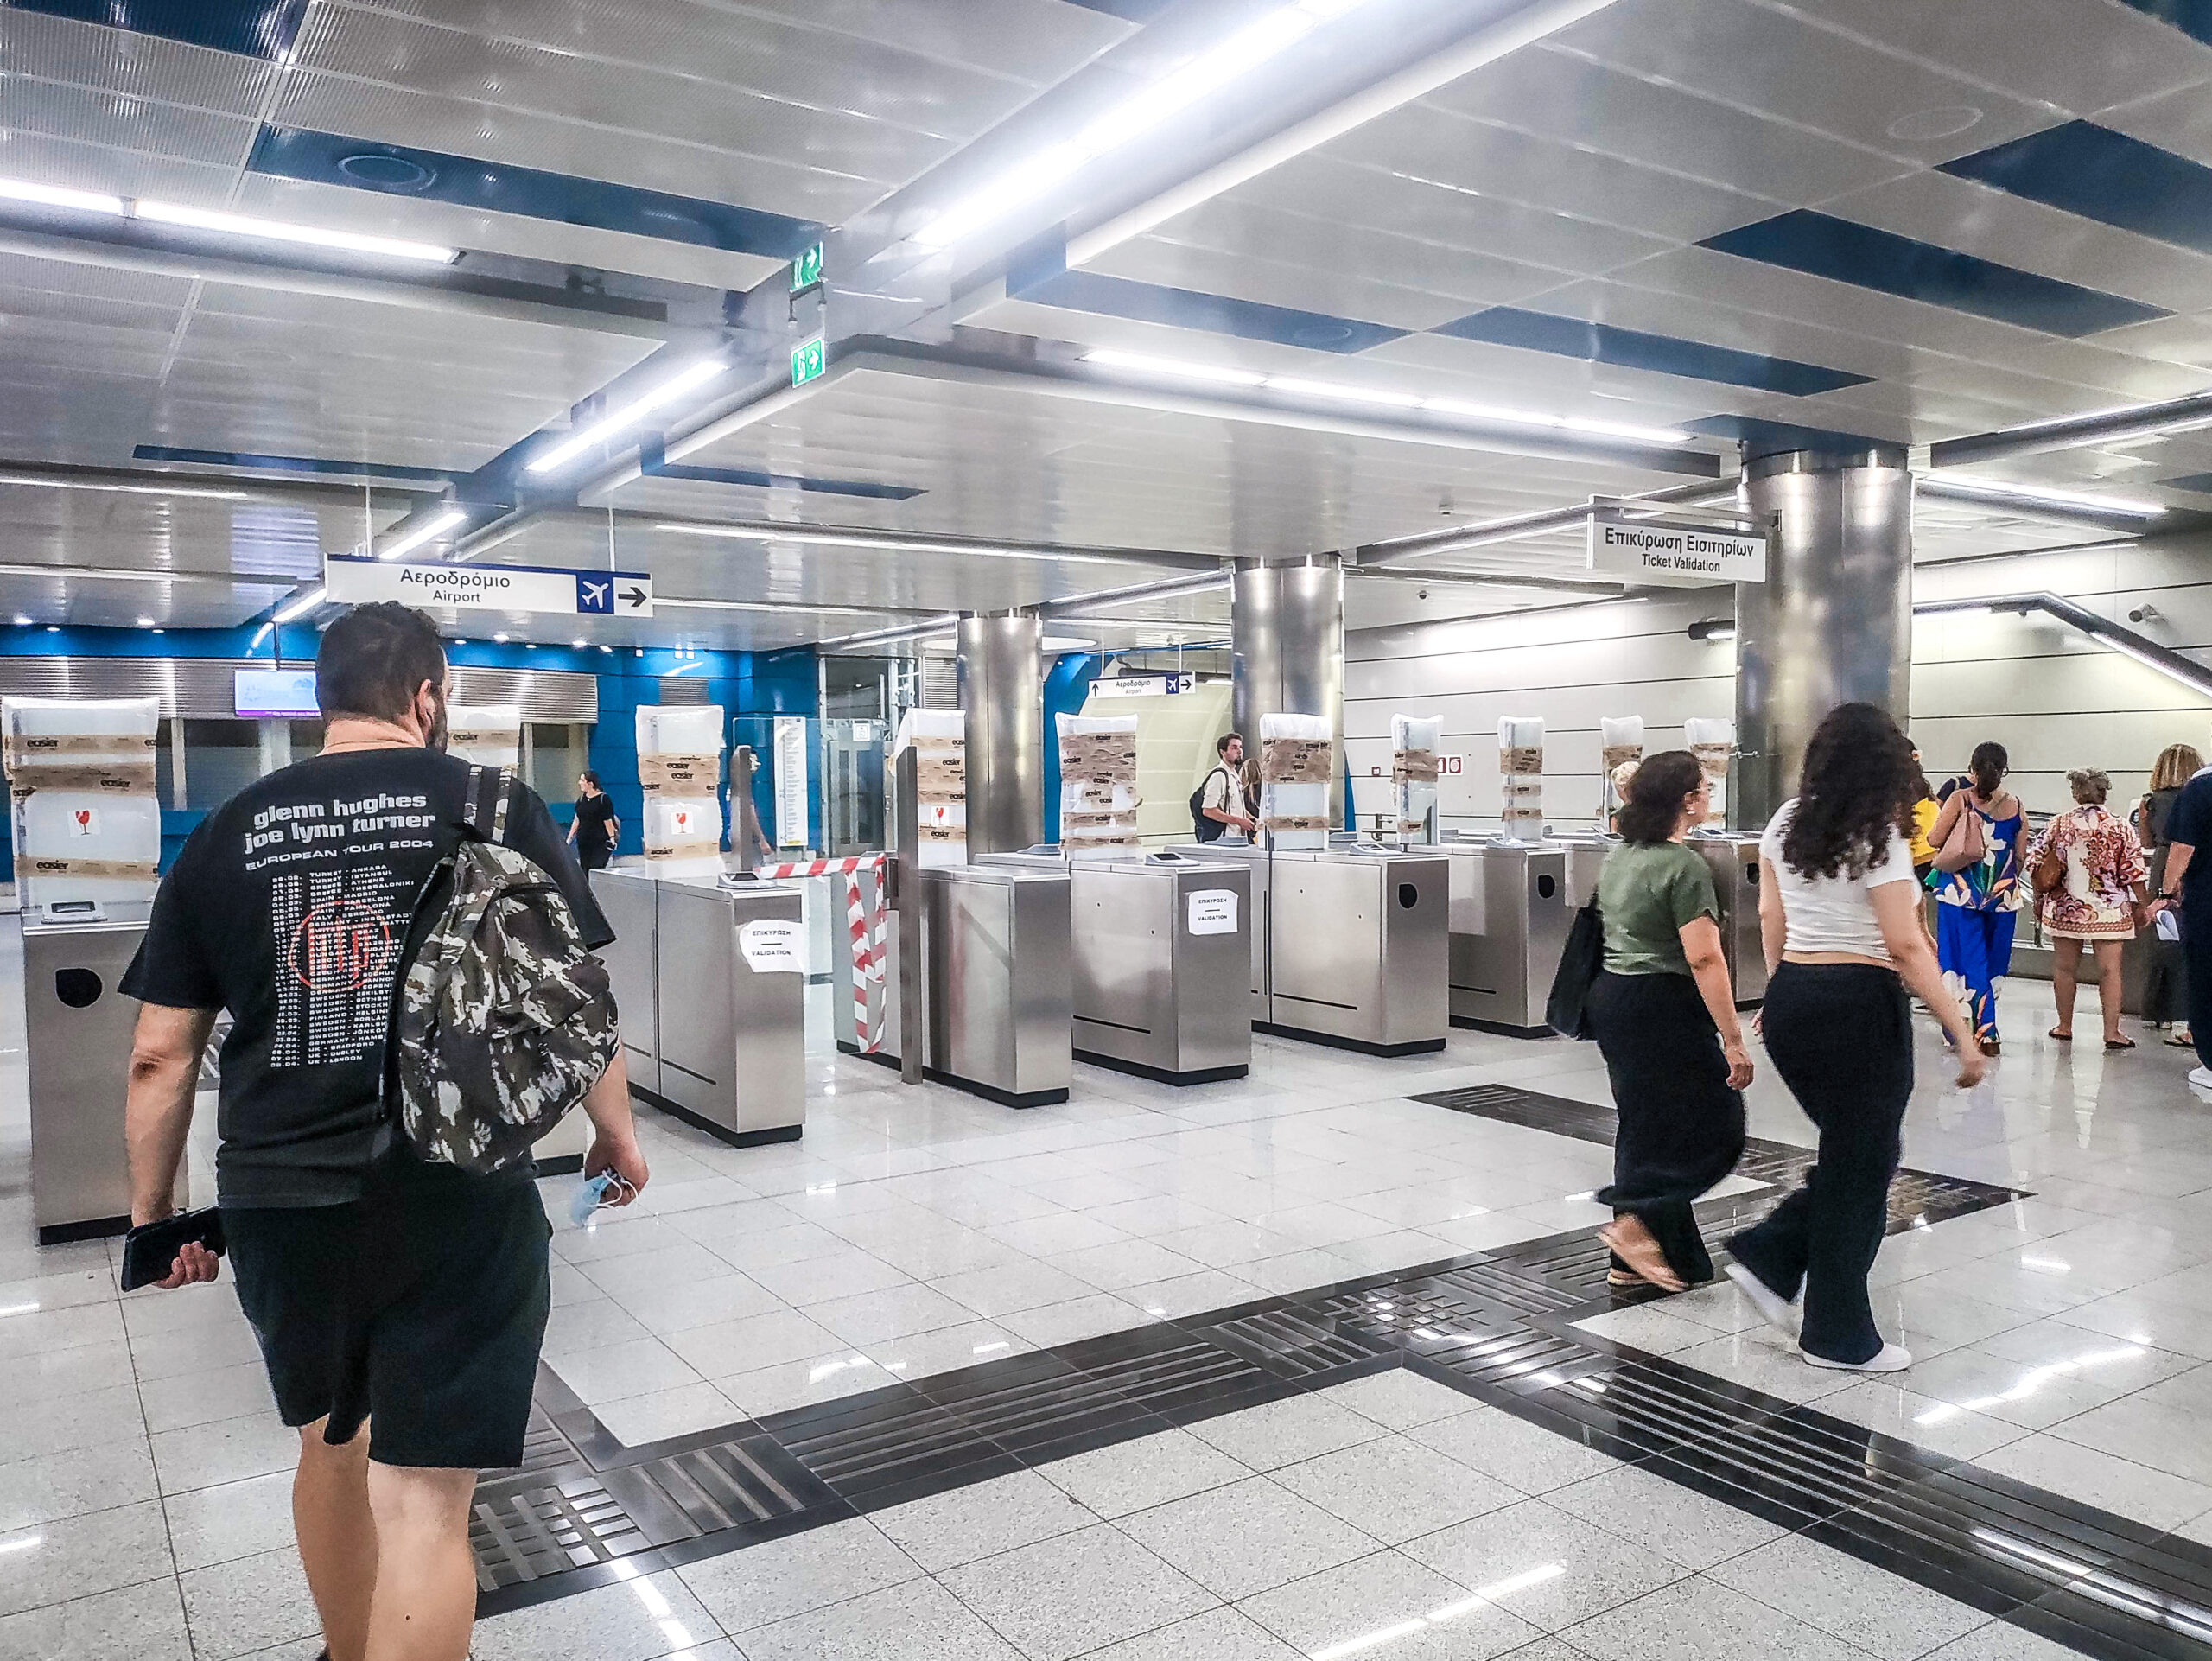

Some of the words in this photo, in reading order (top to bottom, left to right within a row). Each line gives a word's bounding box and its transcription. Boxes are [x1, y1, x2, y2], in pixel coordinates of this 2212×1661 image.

[1605, 527, 1682, 554] Επικύρωση
[1687, 535, 1754, 558] Εισιτηρίων
[1642, 553, 1672, 568] Ticket
[1674, 556, 1721, 572] Validation
[400, 568, 510, 589] Αεροδρόμιο
[433, 590, 481, 604] Airport
[1116, 679, 1151, 688] Αεροδρόμιο
[27, 737, 59, 748] easier
[671, 771, 694, 780] easier
[100, 778, 130, 788] easier
[253, 803, 325, 830] glenn
[333, 792, 427, 816] hughes
[245, 828, 284, 855] joe
[291, 822, 345, 843] lynn
[352, 814, 436, 833] turner
[245, 849, 338, 871] EUROPEAN
[342, 842, 384, 855] TOUR
[389, 840, 435, 849] 2004
[36, 859, 69, 870] easier
[351, 864, 388, 873] ANKARA
[351, 870, 392, 880] ISTANBUL
[344, 890, 378, 899] MADRID
[344, 895, 395, 905] BARCELONA
[309, 949, 351, 958] HUNGARY
[310, 974, 353, 983] GERMANY
[311, 980, 353, 989] GERMANY
[309, 1006, 346, 1015] SWEDEN
[309, 1013, 347, 1021] FINLAND
[309, 1025, 346, 1034] SWEDEN
[309, 1037, 349, 1046] GERMANY
[330, 1041, 375, 1051] BRADFORD
